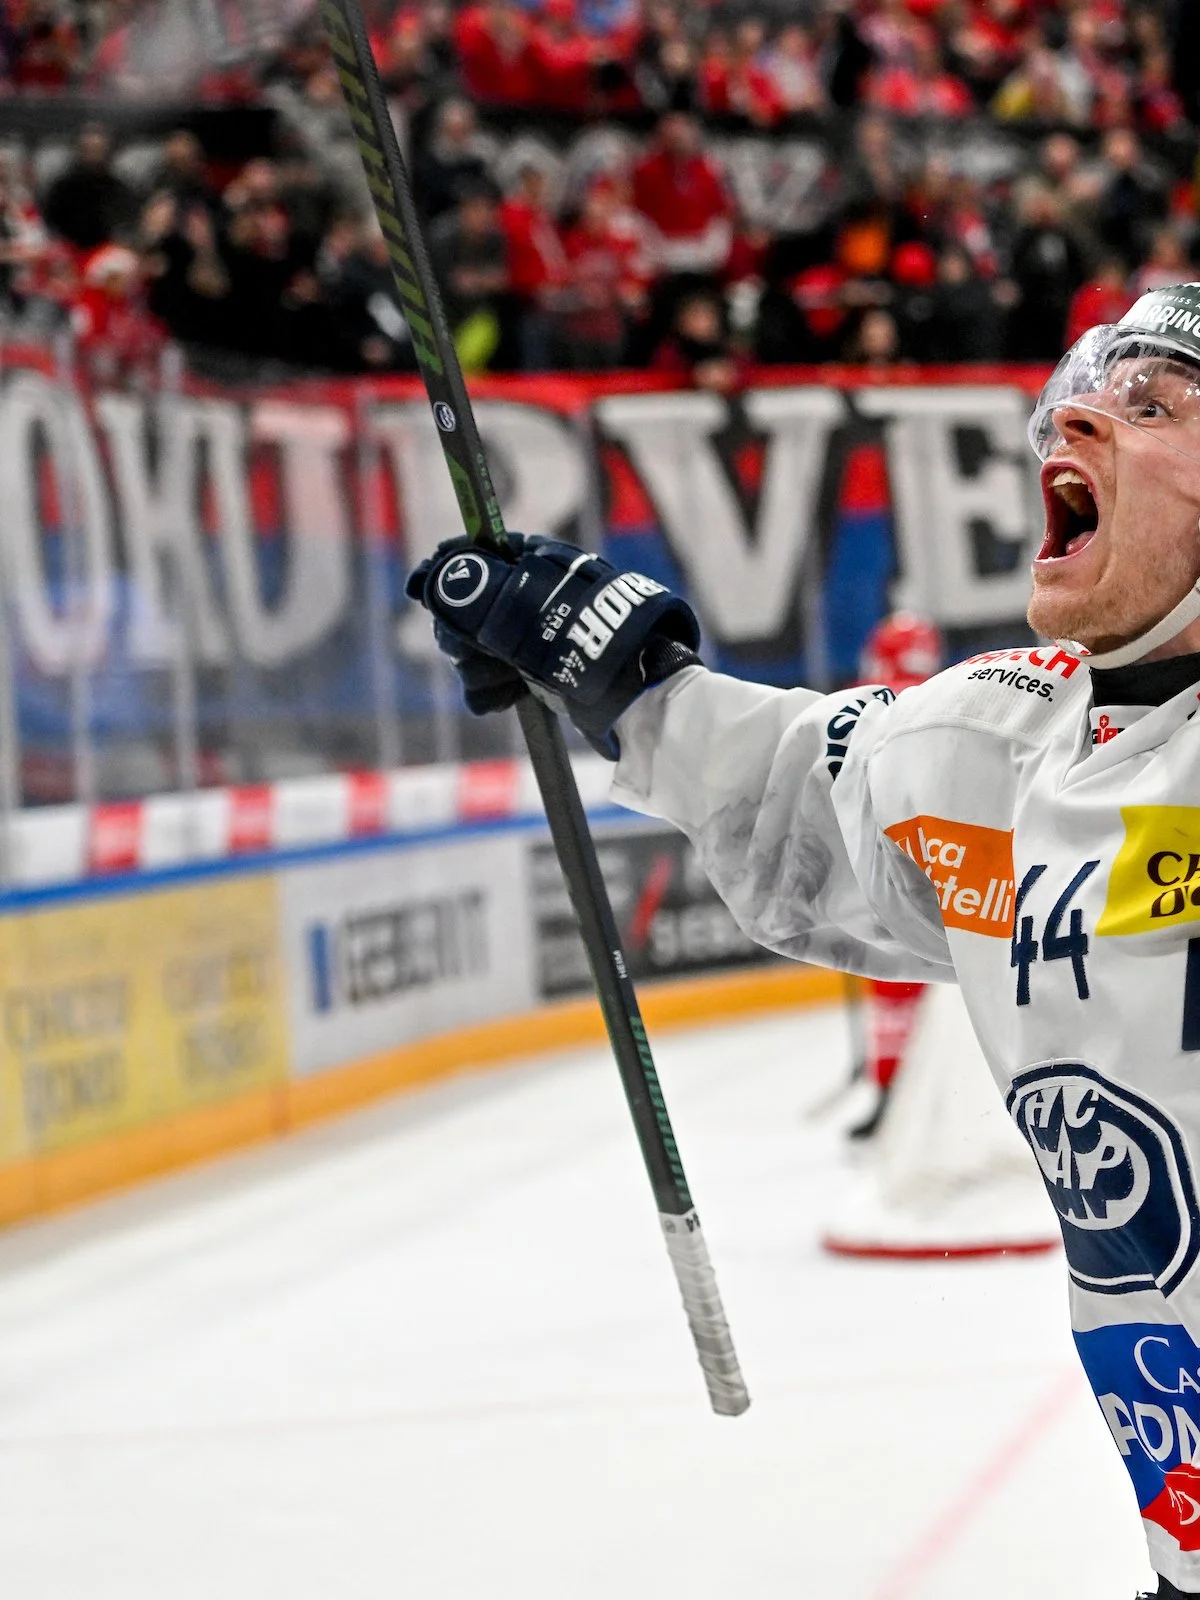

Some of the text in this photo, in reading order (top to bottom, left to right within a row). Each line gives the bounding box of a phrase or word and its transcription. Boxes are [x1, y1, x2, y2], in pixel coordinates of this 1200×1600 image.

[567, 571, 672, 661] RIOR
[967, 667, 1054, 702] services.
[1011, 859, 1101, 1007] 44
